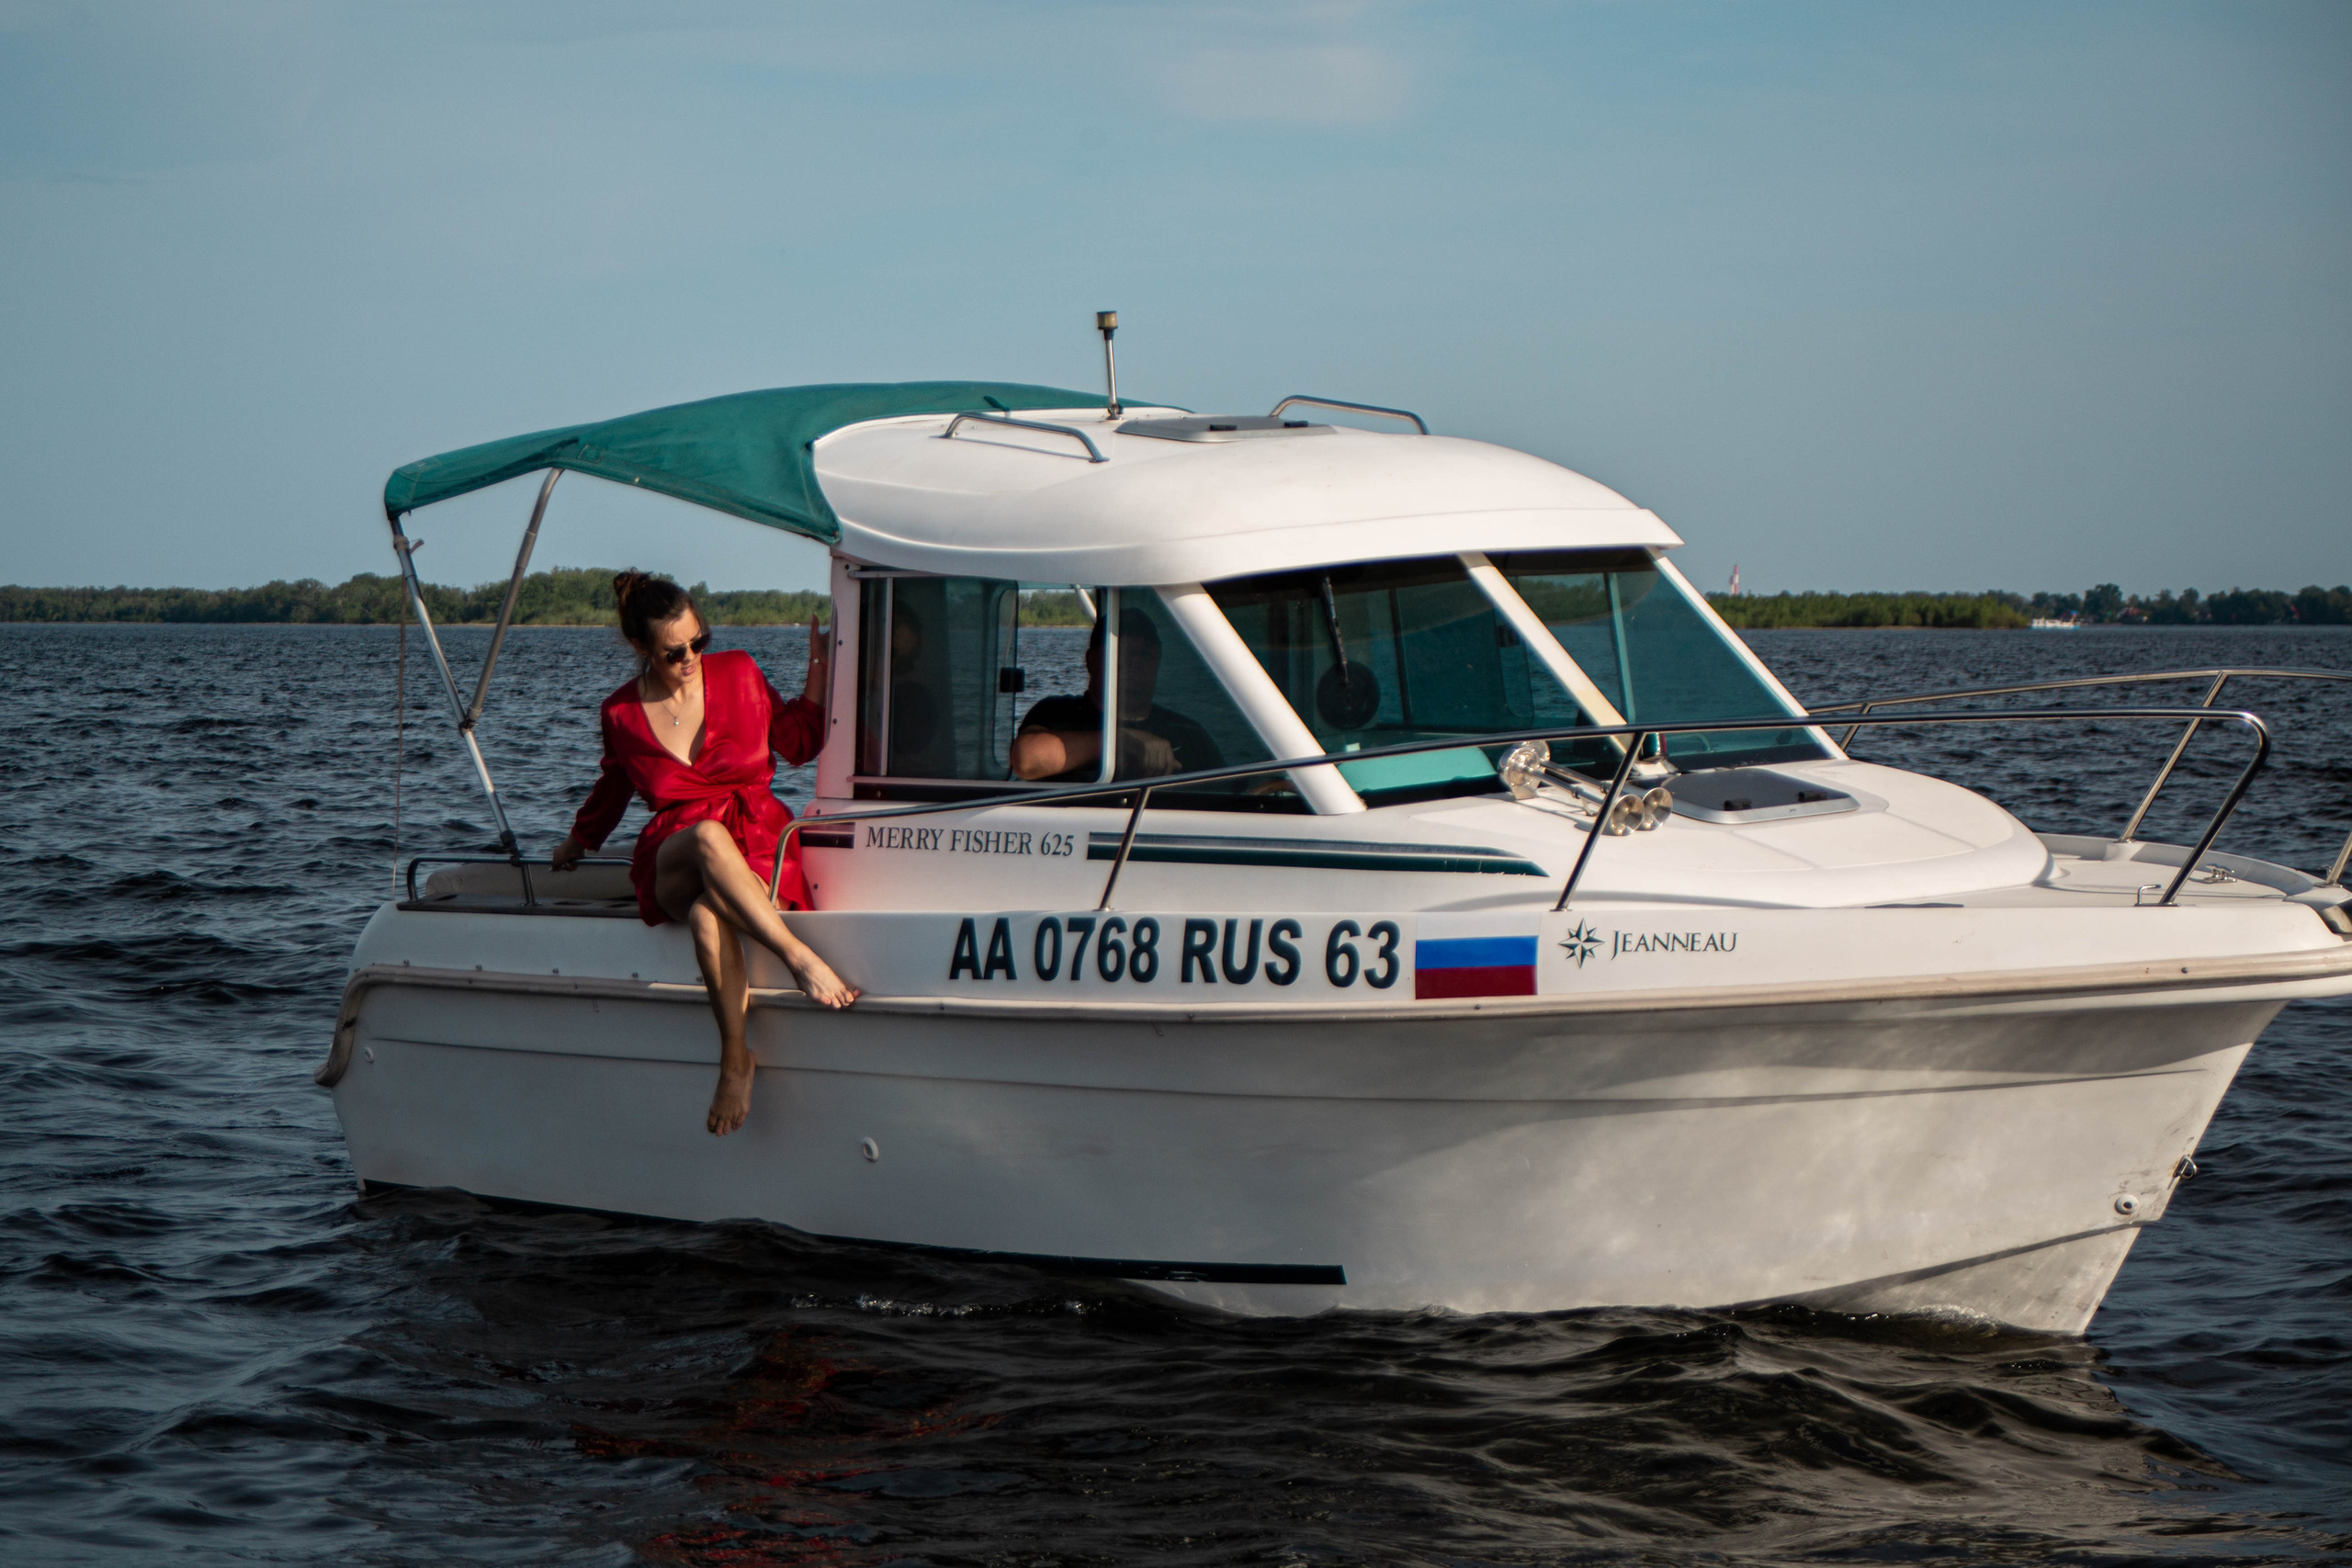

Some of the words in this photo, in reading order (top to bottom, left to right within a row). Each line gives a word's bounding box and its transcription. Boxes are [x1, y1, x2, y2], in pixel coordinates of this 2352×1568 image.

[865, 825, 944, 851] MERRY
[949, 829, 1033, 855] FISHER
[1040, 831, 1075, 857] 625
[948, 917, 1018, 981] AA
[1033, 916, 1160, 983] 0768
[1180, 918, 1303, 987] RUS
[1325, 919, 1401, 989] 63
[1611, 931, 1738, 961] JEANNEAU
